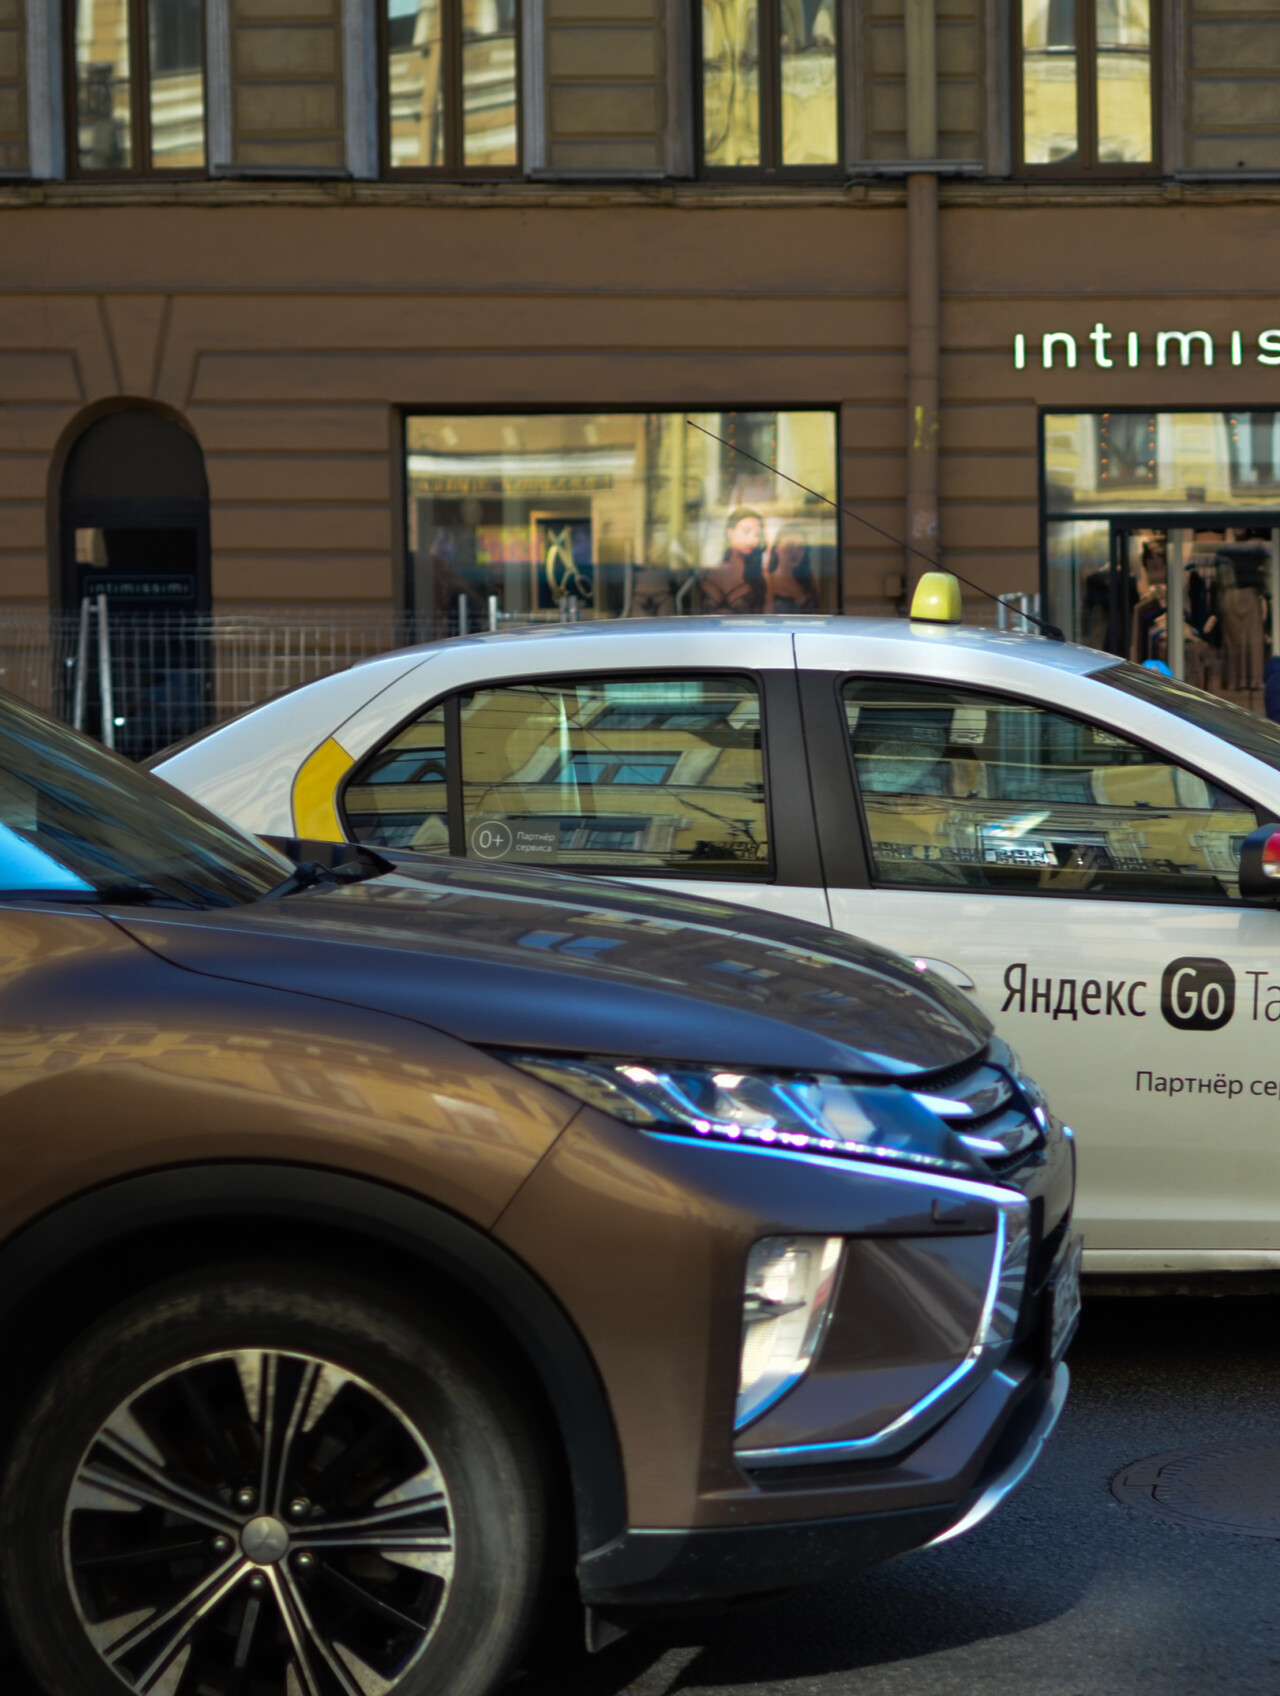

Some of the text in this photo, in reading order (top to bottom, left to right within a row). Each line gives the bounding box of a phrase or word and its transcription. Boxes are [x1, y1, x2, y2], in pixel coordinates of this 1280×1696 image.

[89, 583, 189, 594] intimissimi
[479, 830, 504, 849] 0+
[515, 844, 553, 853] сервиса
[1000, 963, 1148, 1021] Яндекс
[1170, 966, 1226, 1020] Go
[1136, 1071, 1244, 1100] Партнёр
